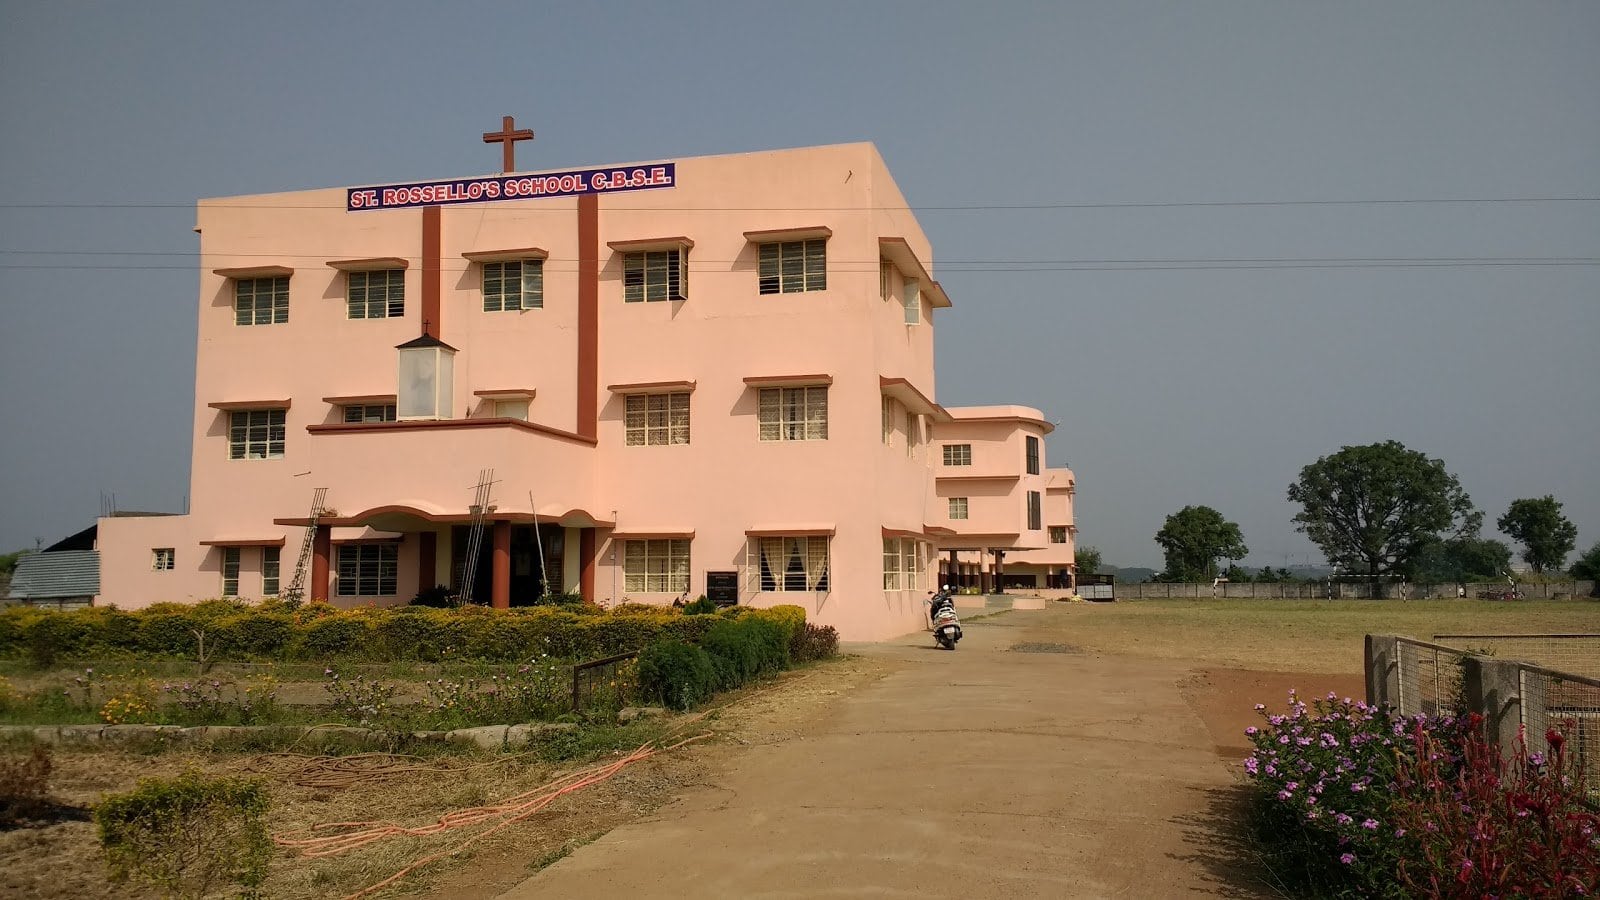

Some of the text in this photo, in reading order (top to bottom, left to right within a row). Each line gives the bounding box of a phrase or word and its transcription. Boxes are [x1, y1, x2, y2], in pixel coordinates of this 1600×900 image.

[350, 167, 672, 208] ST. ROSSELLO'S SCHOOL C.B.S.E.
